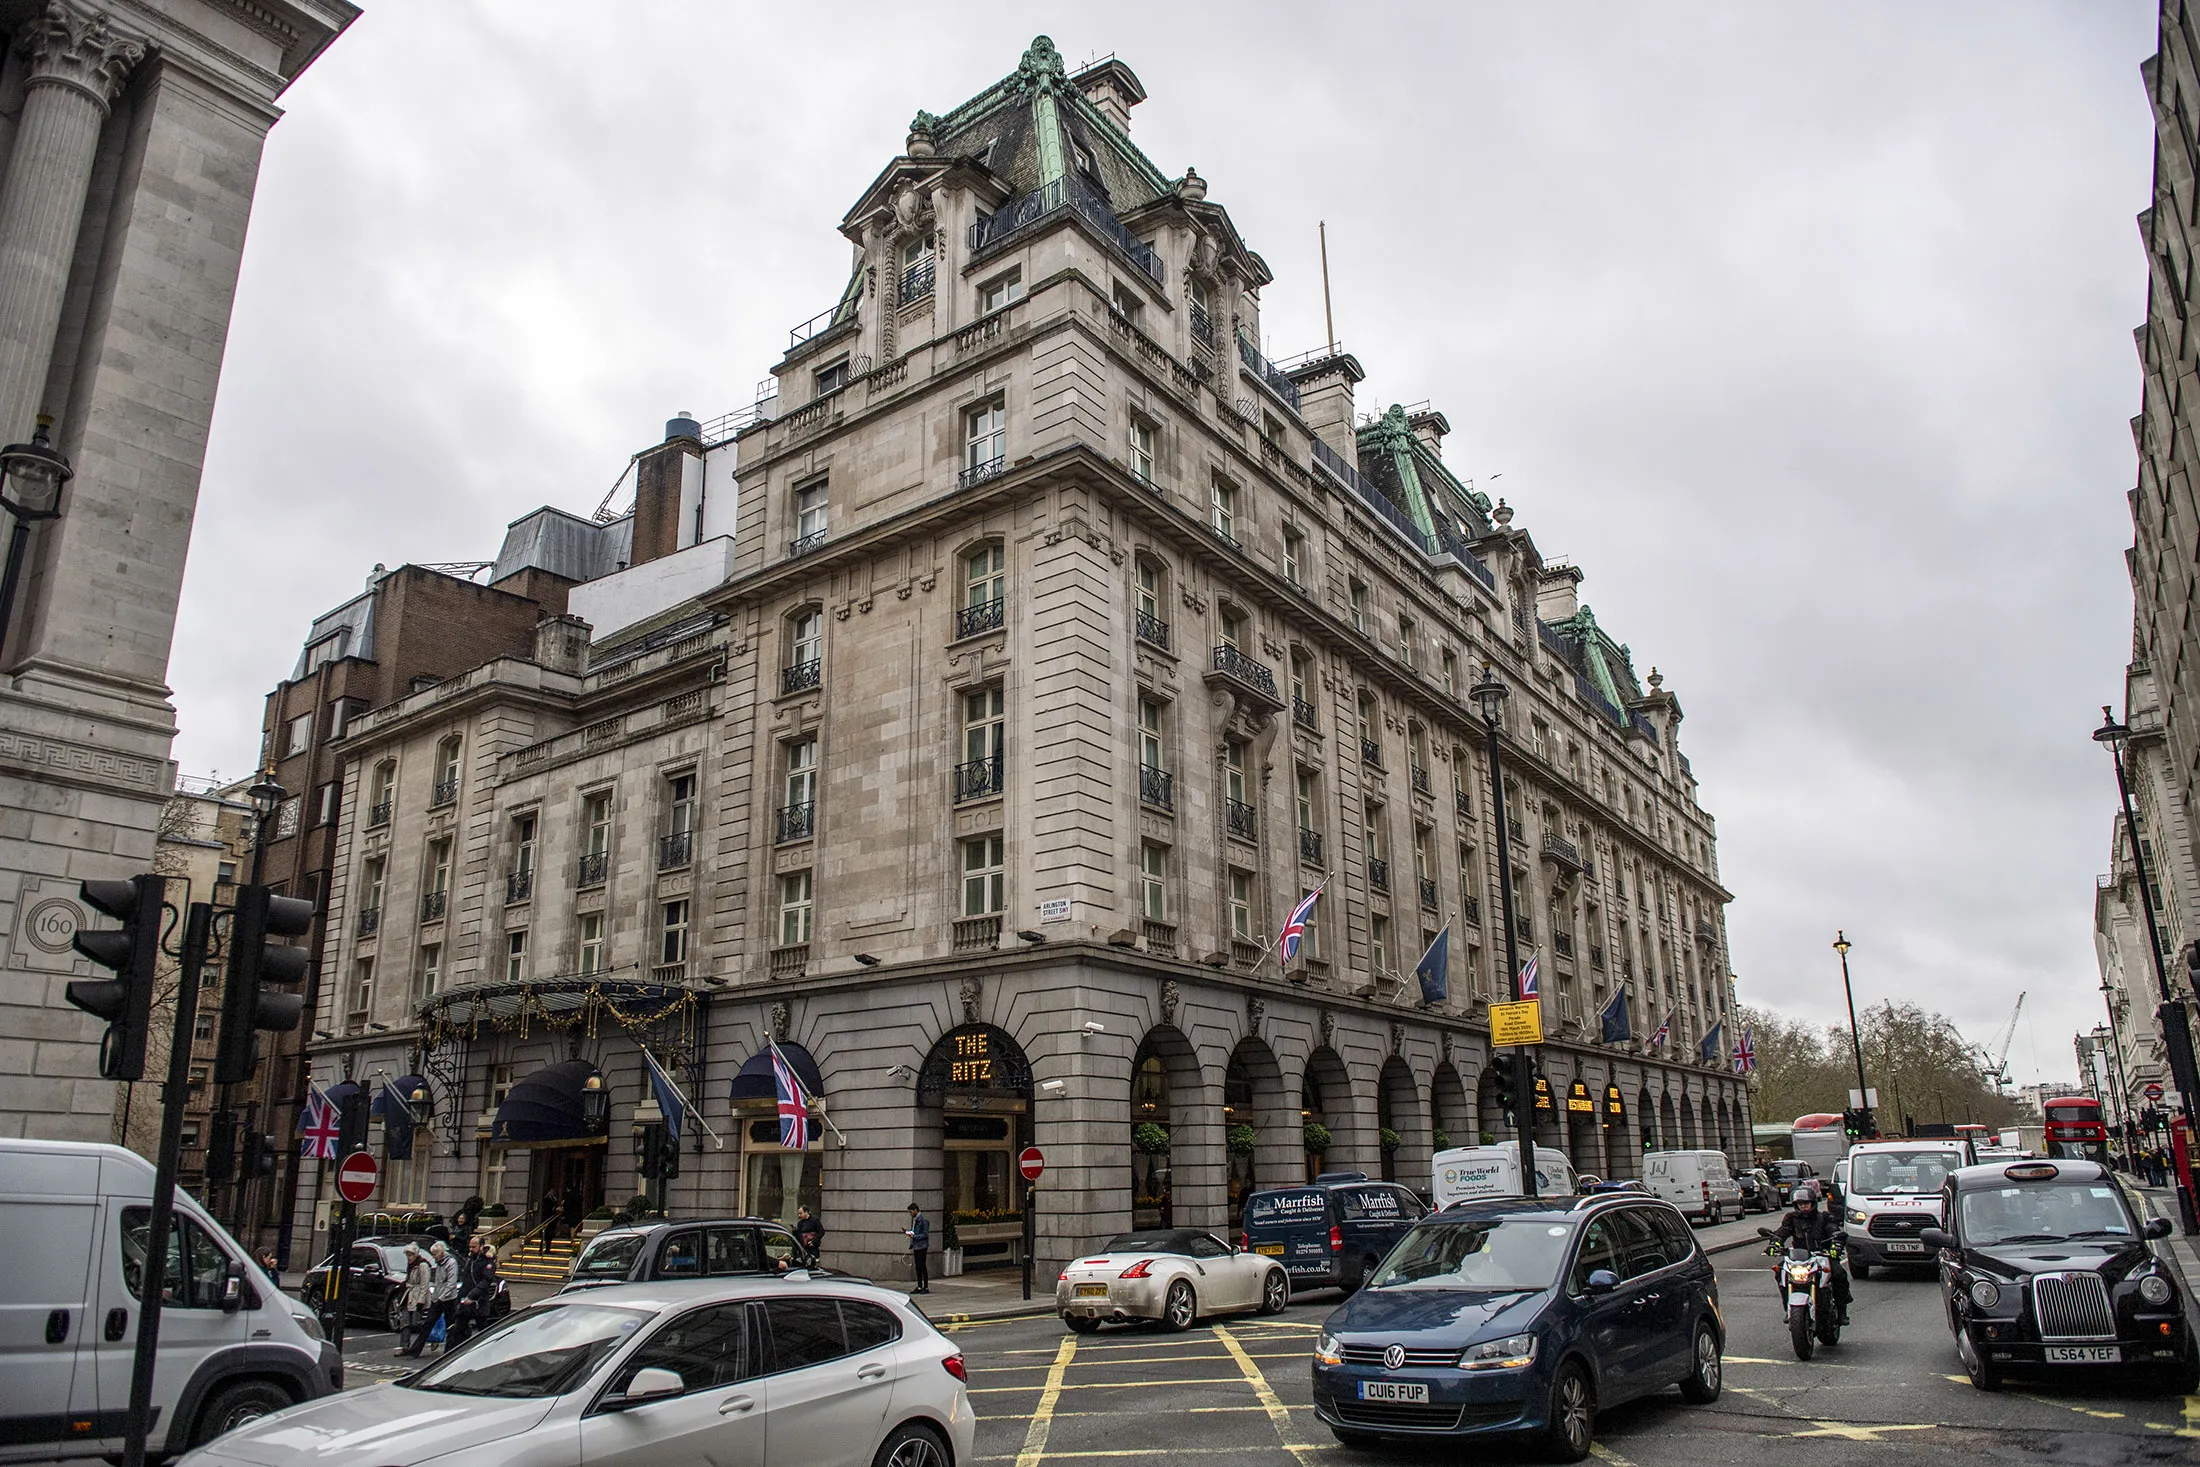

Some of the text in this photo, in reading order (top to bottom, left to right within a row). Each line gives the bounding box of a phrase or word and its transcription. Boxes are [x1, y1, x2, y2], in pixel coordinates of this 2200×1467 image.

[1043, 901, 1067, 909] ARLINGTON
[1043, 908, 1059, 916] STREET
[41, 912, 72, 934] 160
[955, 1034, 987, 1055] THE
[952, 1060, 991, 1081] RITZ
[2085, 1128, 2095, 1136] 38
[1477, 1166, 1499, 1174] World
[1650, 1161, 1667, 1175] J&J
[1460, 1174, 1487, 1182] FOODS
[1274, 1195, 1324, 1209] Marrfish
[1358, 1193, 1398, 1209] Marrfish
[1369, 1210, 1380, 1218] Caught
[1891, 1243, 1920, 1251] ET19 TNF
[2051, 1348, 2114, 1360] LS64 YEF
[1368, 1384, 1423, 1400] CU16 FUP
